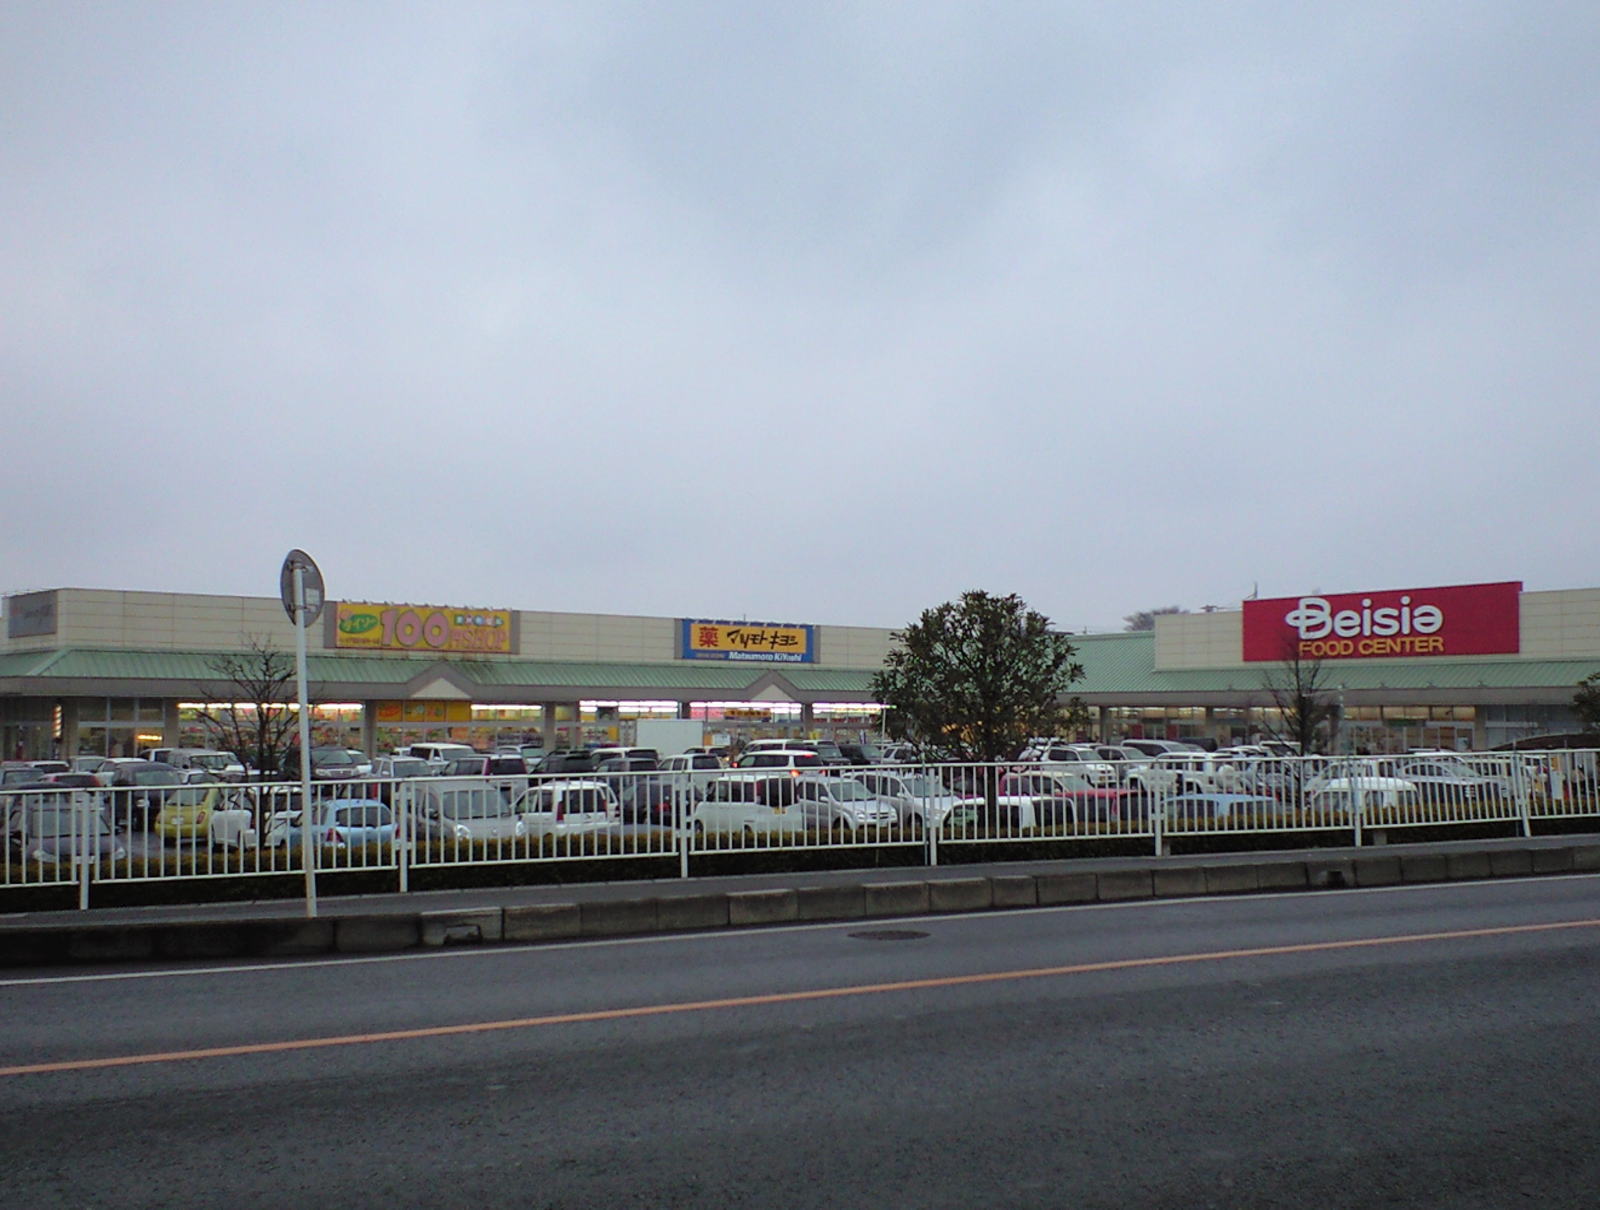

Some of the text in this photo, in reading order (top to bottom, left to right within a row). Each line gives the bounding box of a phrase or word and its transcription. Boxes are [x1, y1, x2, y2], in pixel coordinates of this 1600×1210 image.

[381, 610, 449, 647] 100
[1286, 596, 1444, 639] Beisia
[1299, 637, 1444, 656] FOOD CENTER
